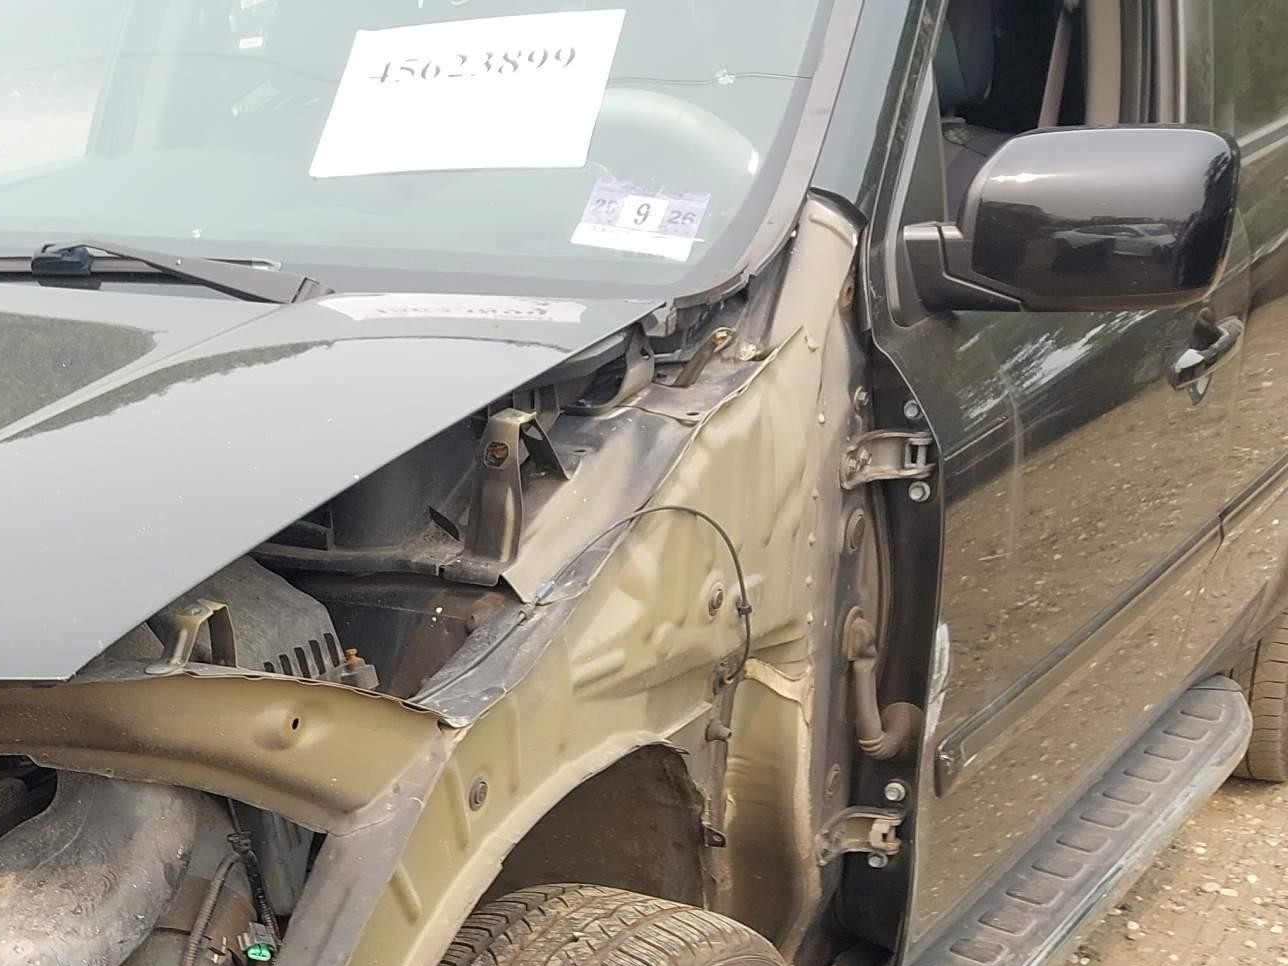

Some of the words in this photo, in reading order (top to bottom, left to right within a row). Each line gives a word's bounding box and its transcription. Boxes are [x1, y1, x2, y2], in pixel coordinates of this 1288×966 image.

[367, 46, 578, 84] 45623899
[632, 202, 652, 226] 9
[667, 209, 697, 226] 26
